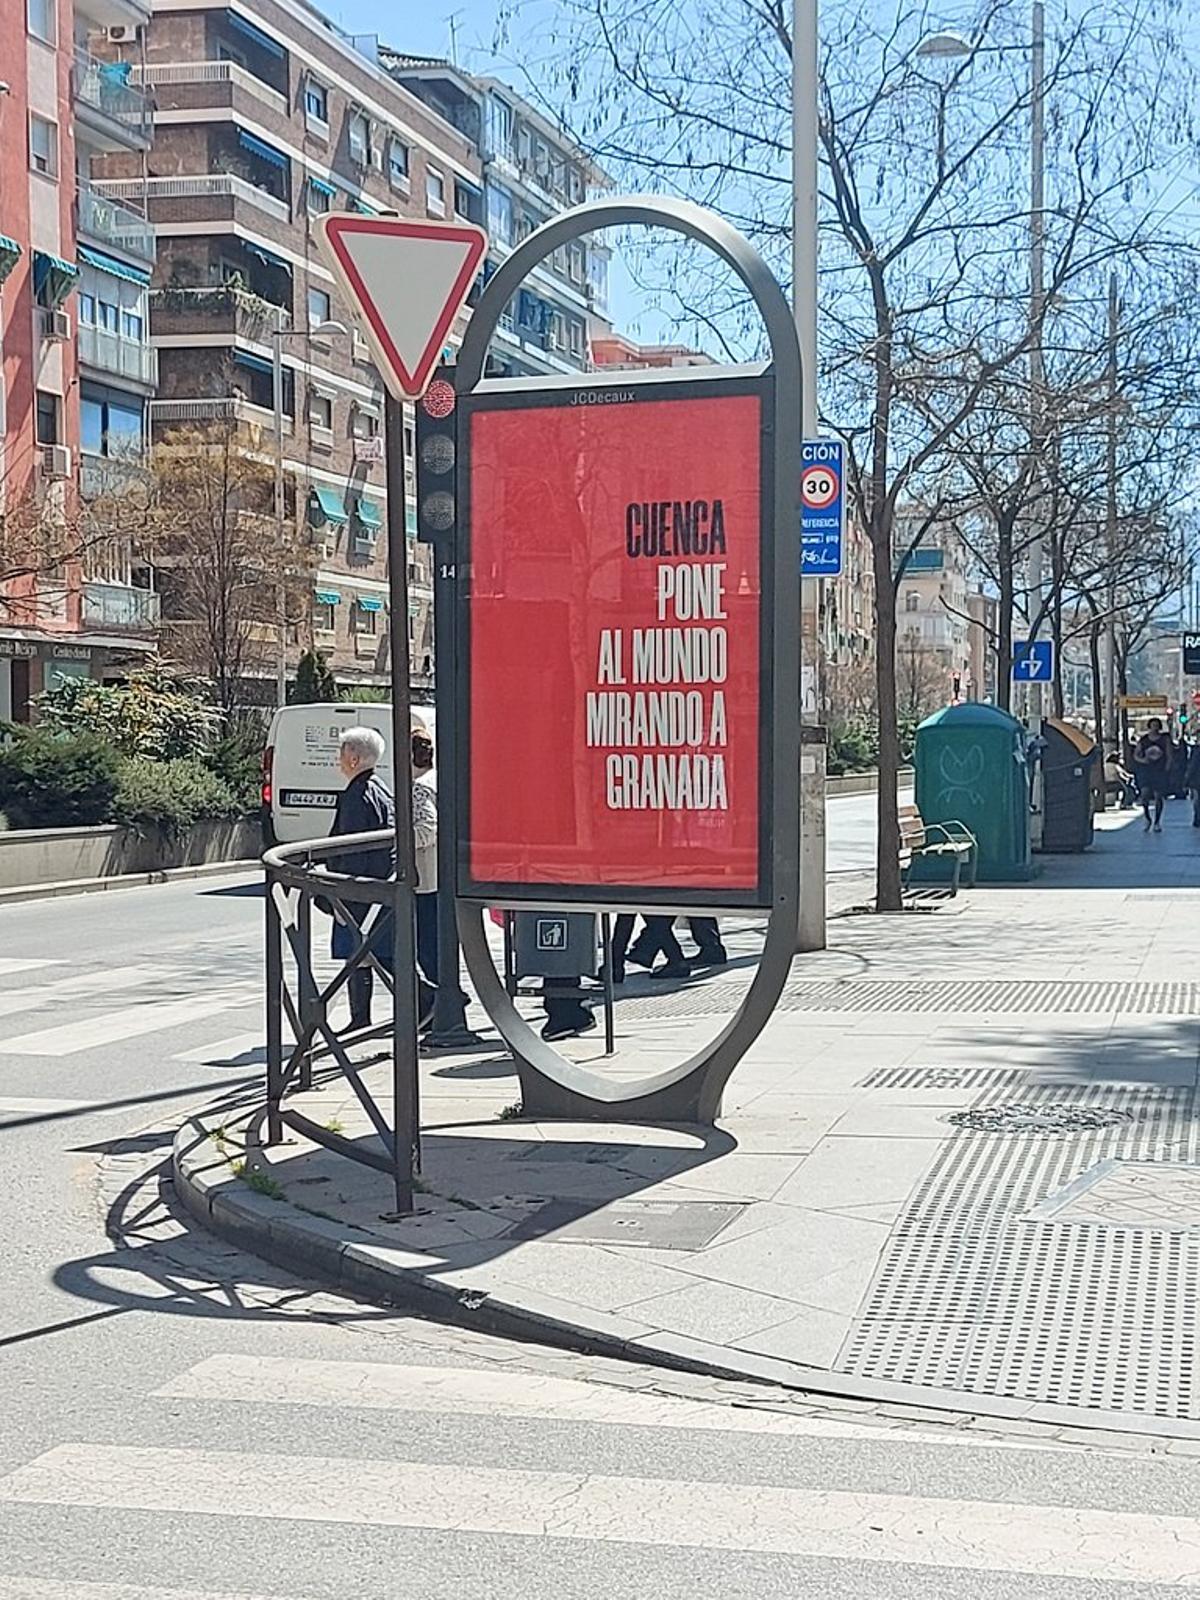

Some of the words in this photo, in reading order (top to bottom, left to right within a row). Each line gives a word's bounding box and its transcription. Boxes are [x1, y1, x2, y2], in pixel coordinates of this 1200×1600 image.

[570, 391, 635, 405] JCDecaux
[806, 479, 830, 494] 30
[626, 499, 727, 558] CUENCA
[439, 564, 456, 579] 14
[657, 562, 728, 621] PONE
[597, 628, 627, 685] AL
[632, 626, 728, 684] MUNDO
[586, 690, 704, 748] MIRANDO
[709, 690, 728, 747] A
[606, 753, 729, 811] GRANADA
